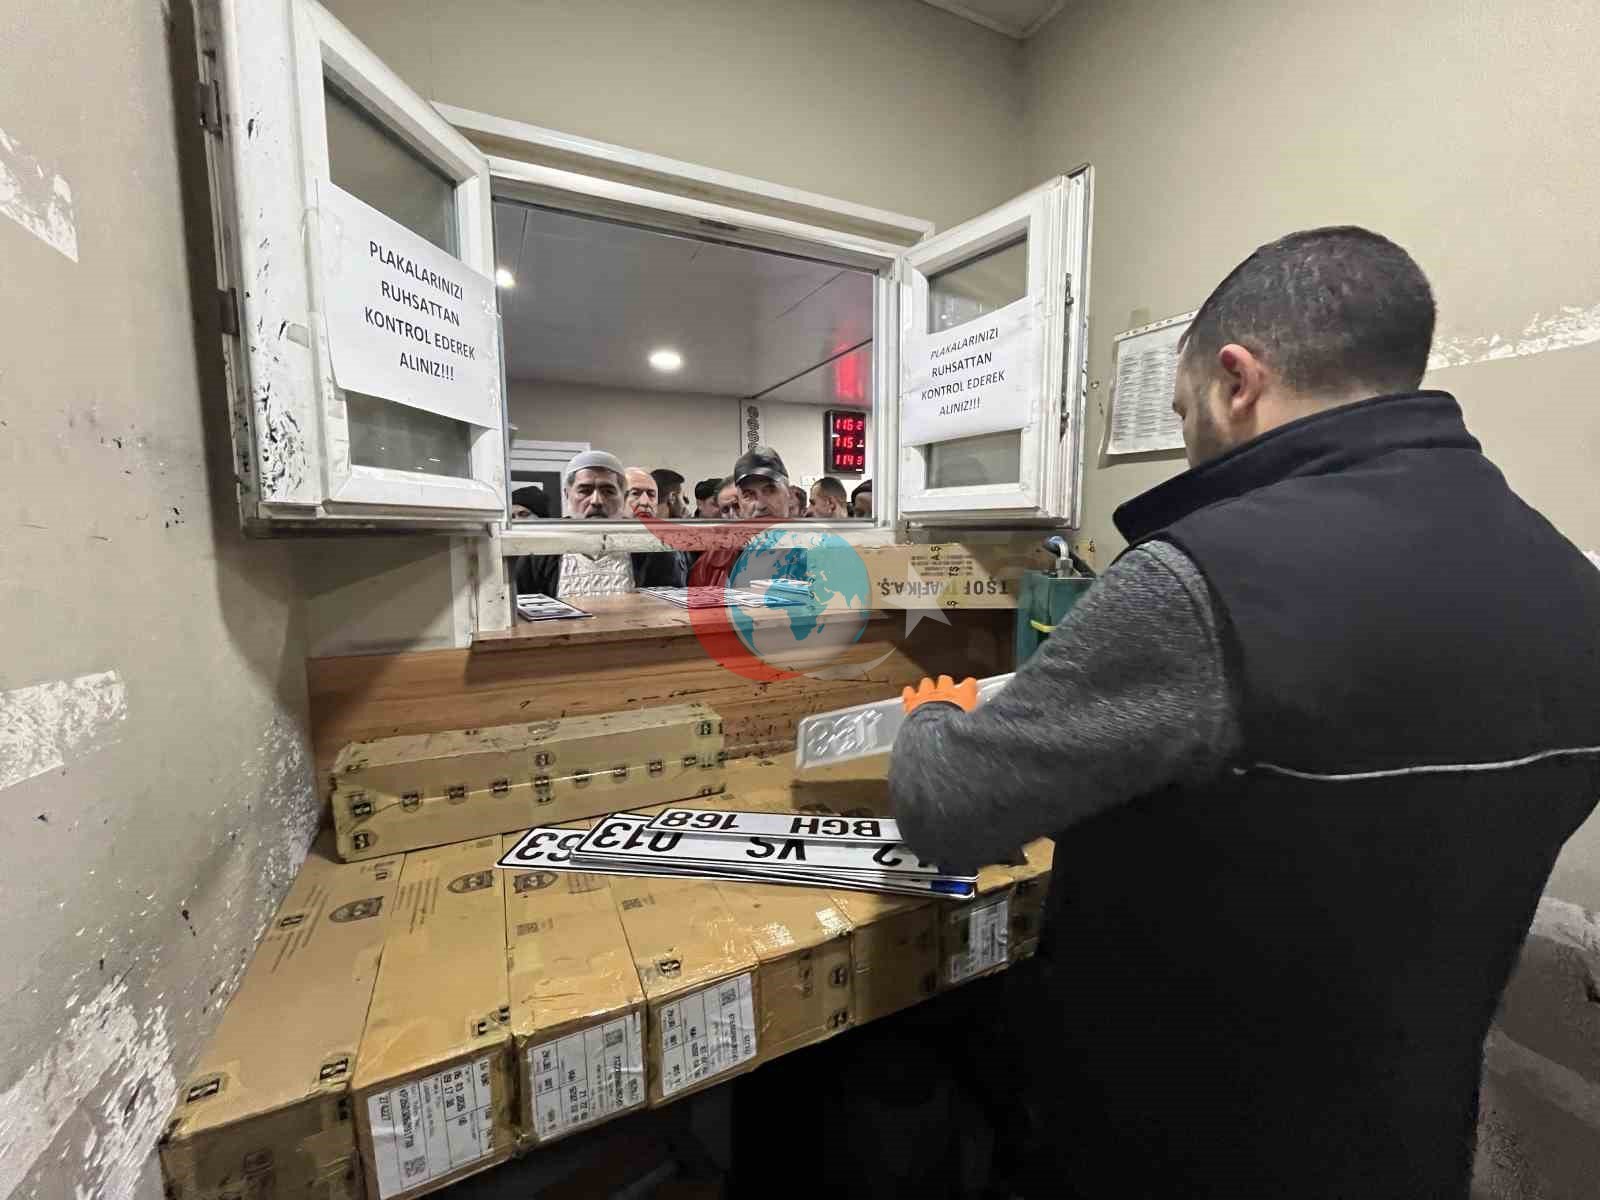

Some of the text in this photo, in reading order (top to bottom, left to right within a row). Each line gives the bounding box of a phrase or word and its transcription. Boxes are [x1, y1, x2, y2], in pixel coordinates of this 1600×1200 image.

[369, 241, 464, 301] PLAKALARINIZI
[381, 280, 460, 327] RUHSATTAN
[365, 306, 476, 361] KONTROL EDEREK
[930, 327, 999, 360] PLAKALARINIZI
[399, 352, 455, 381] ALINIZ!!!
[931, 352, 992, 378] RUHSATTAN
[921, 369, 1005, 401] KONTROL EDEREK
[938, 396, 981, 416] ALINIZ!!!
[836, 437, 853, 449] 115
[836, 454, 854, 465] 114
[907, 581, 958, 599] TAFİK
[593, 822, 683, 852] 013
[660, 811, 881, 838] BGH 168
[745, 836, 807, 861] VS
